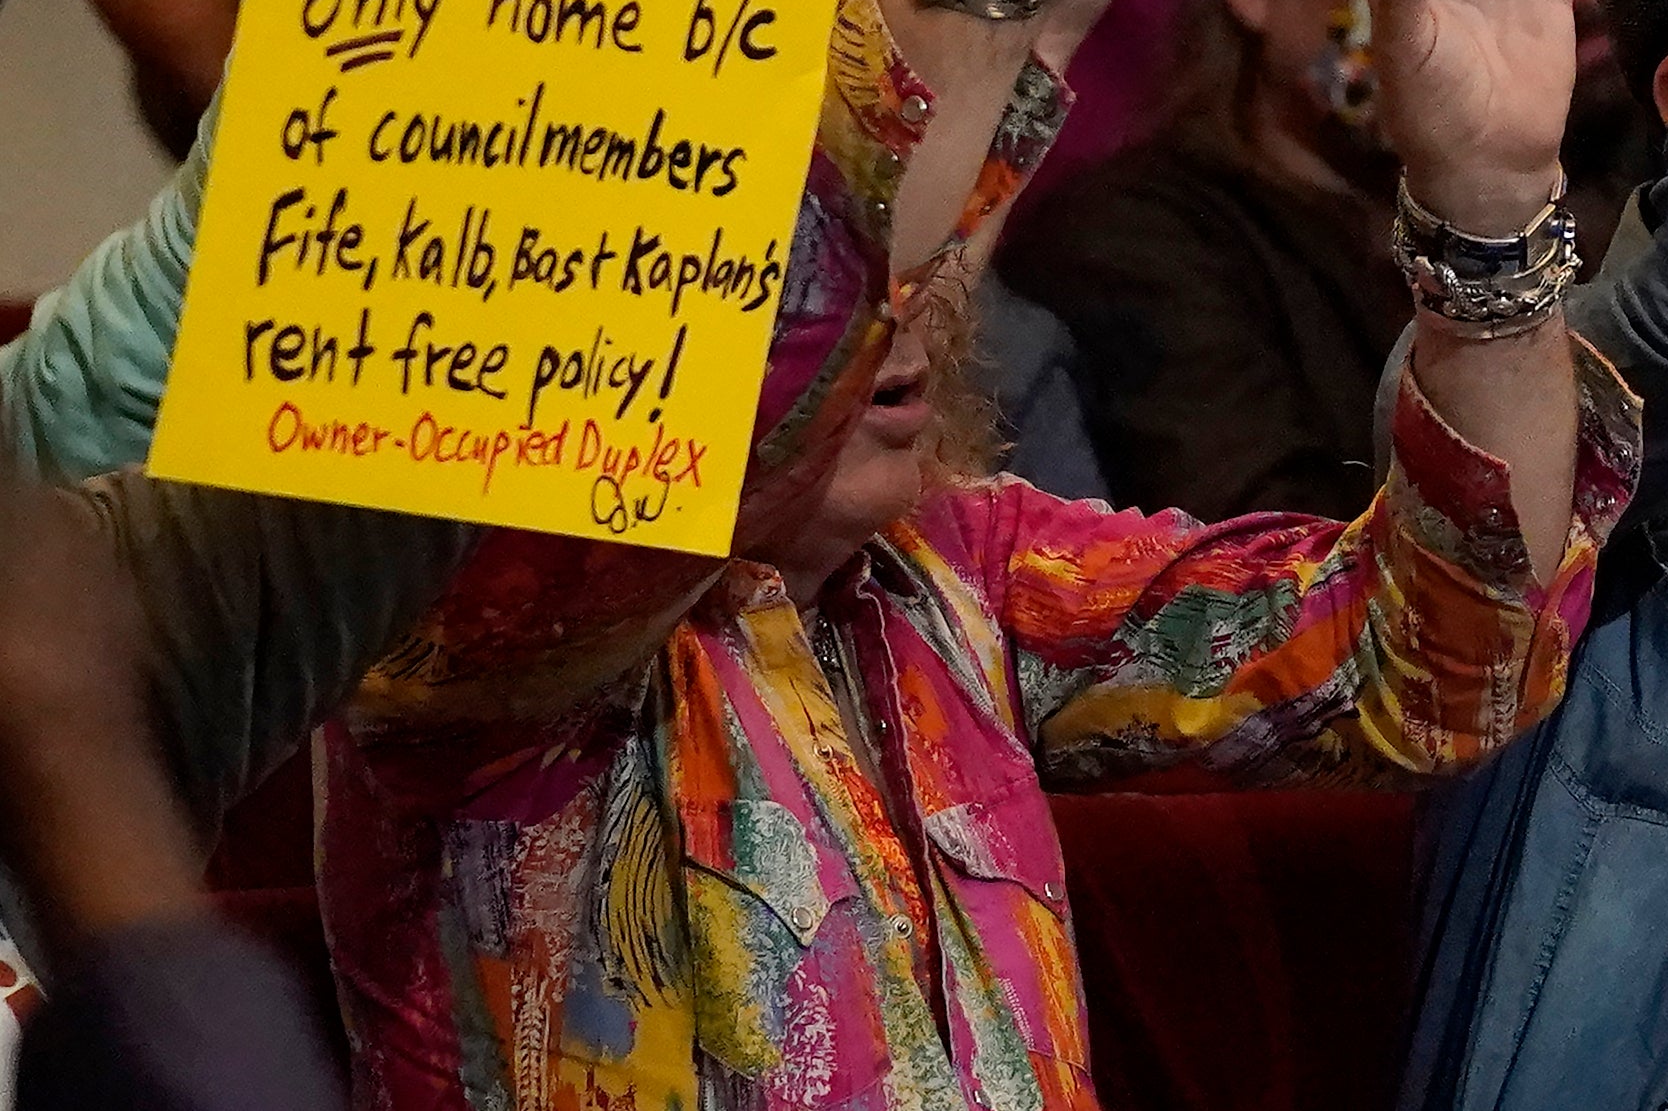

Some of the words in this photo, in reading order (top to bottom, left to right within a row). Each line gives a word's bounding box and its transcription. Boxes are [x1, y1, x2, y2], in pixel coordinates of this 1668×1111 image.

[280, 85, 340, 167] of
[256, 187, 378, 291] Fife,
[391, 197, 499, 303] Kalb,
[622, 225, 782, 316] Kaplan's
[243, 308, 376, 385] rent
[391, 311, 510, 400] free
[532, 325, 689, 426] policy!
[267, 401, 571, 495] Owner-Occupied
[574, 418, 708, 498] Duplex
